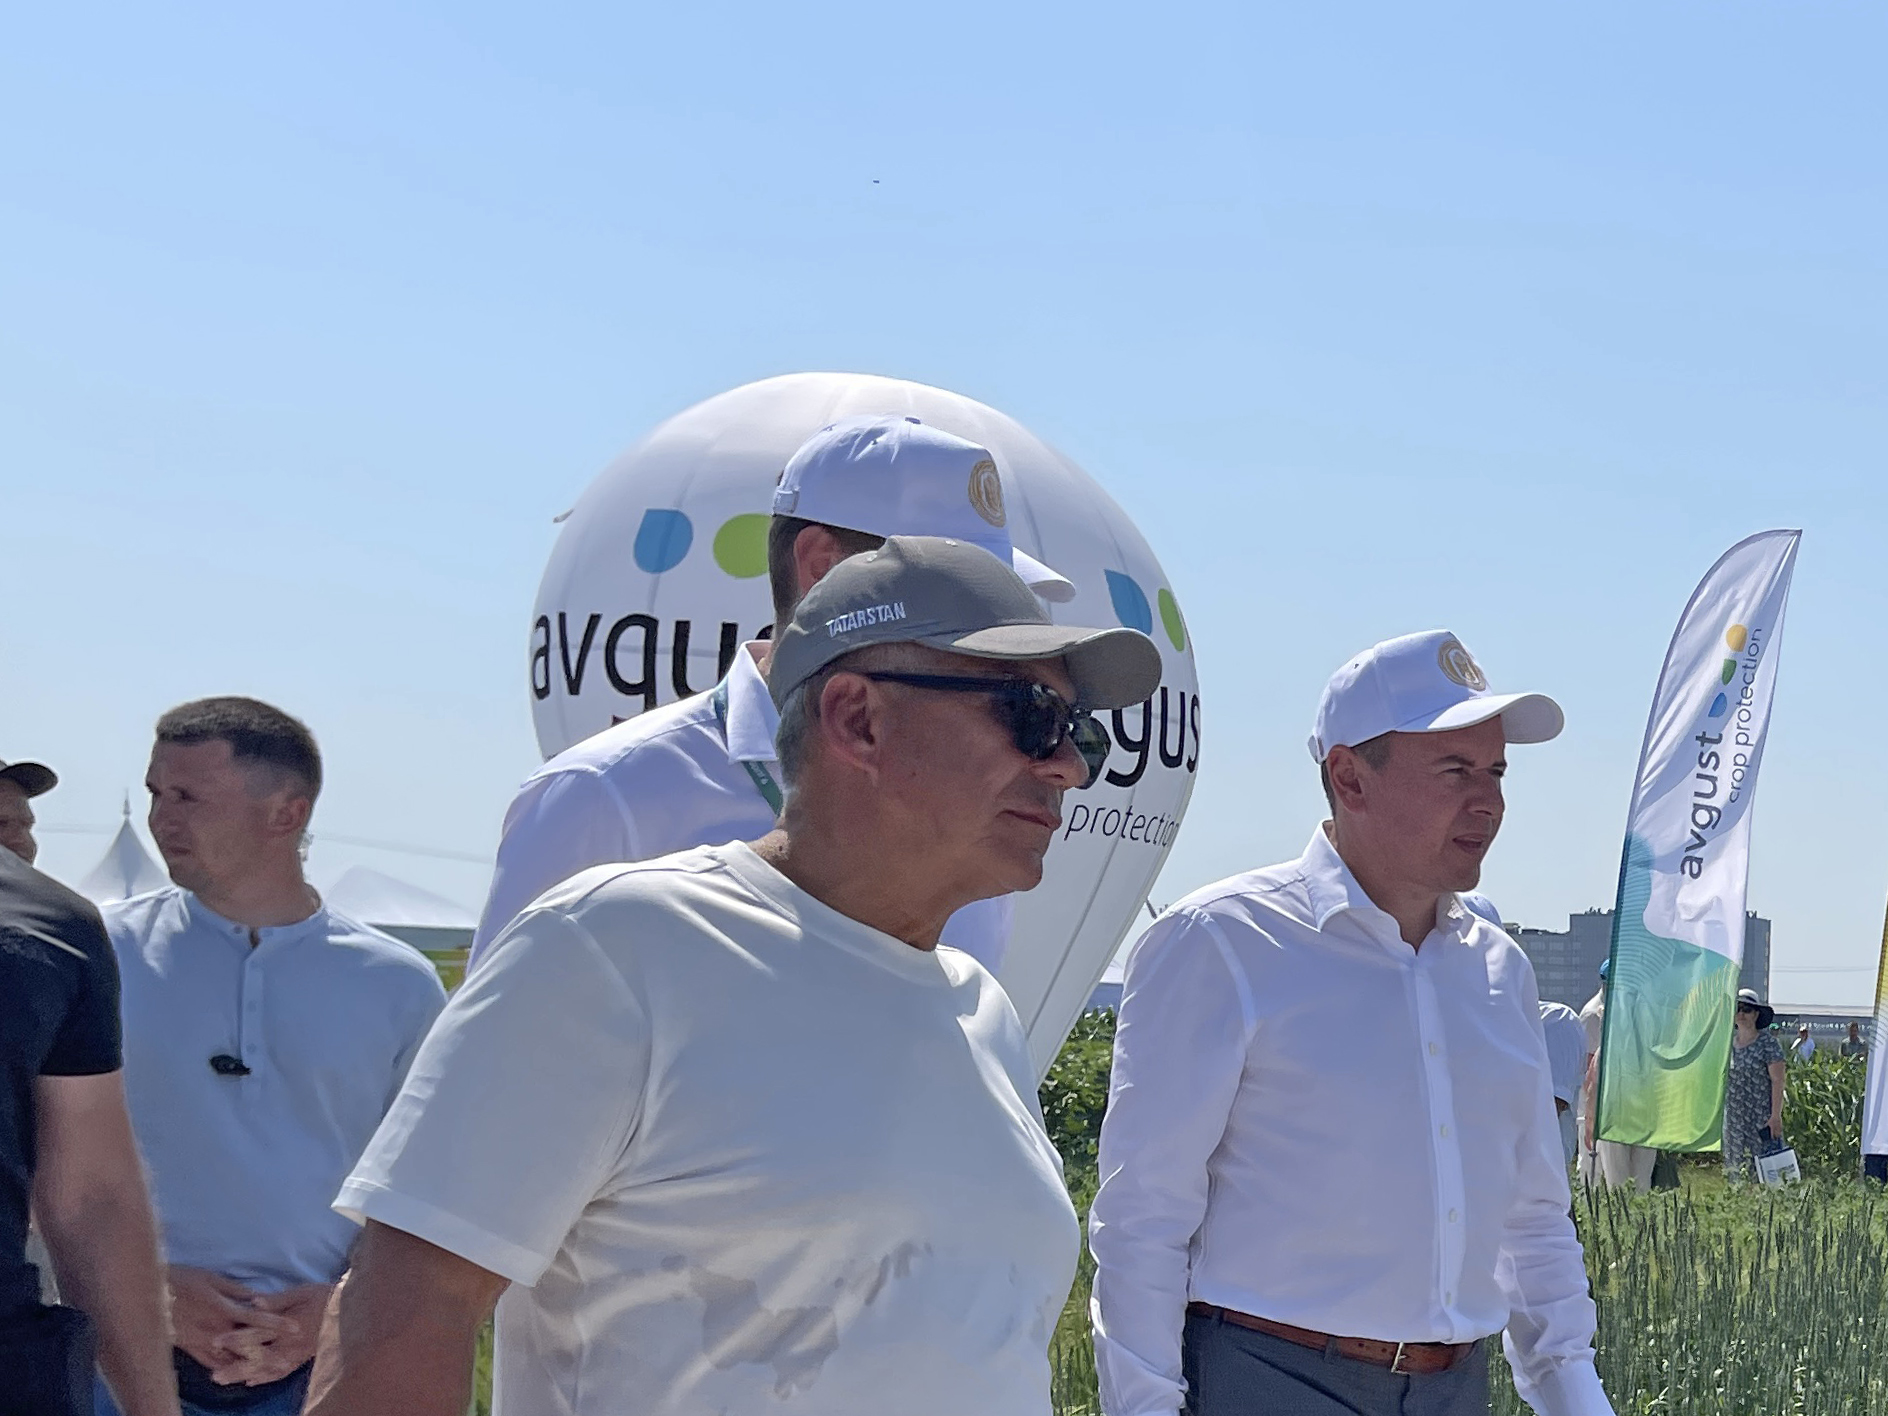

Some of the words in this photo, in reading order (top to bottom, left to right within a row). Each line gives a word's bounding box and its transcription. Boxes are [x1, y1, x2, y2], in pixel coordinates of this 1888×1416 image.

[532, 611, 774, 713] avgu
[825, 602, 906, 638] TATARSTAN
[1735, 628, 1762, 747] protection
[1680, 731, 1723, 880] avgust
[1729, 752, 1750, 804] crop
